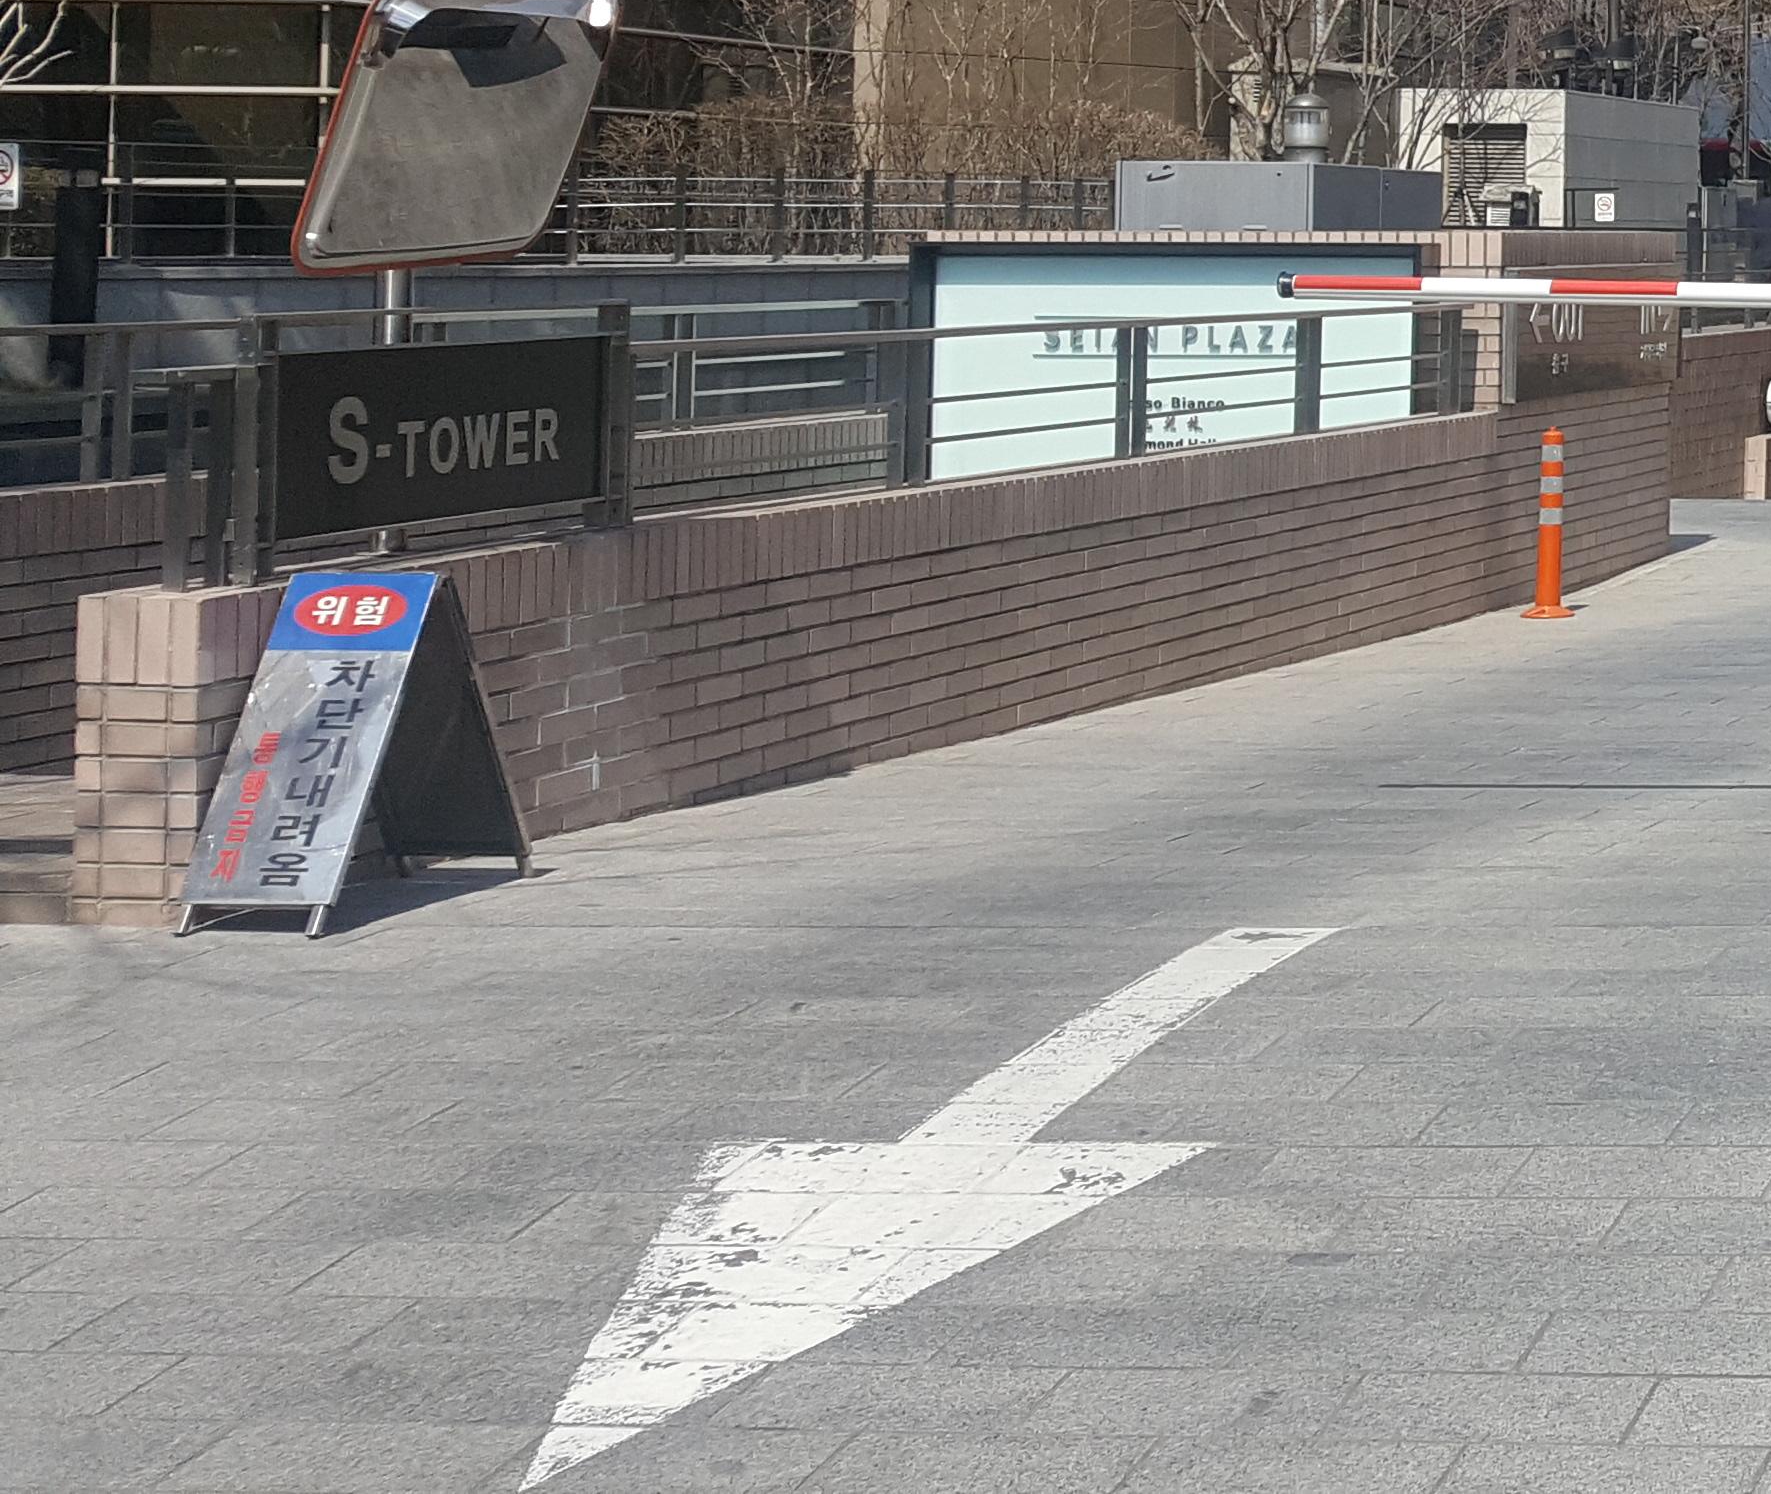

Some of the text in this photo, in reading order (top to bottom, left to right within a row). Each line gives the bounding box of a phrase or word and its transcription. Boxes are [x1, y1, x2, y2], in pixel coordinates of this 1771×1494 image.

[1181, 324, 1296, 354] PLAZA
[327, 395, 560, 485] S-TOWER
[311, 595, 390, 626] 위험
